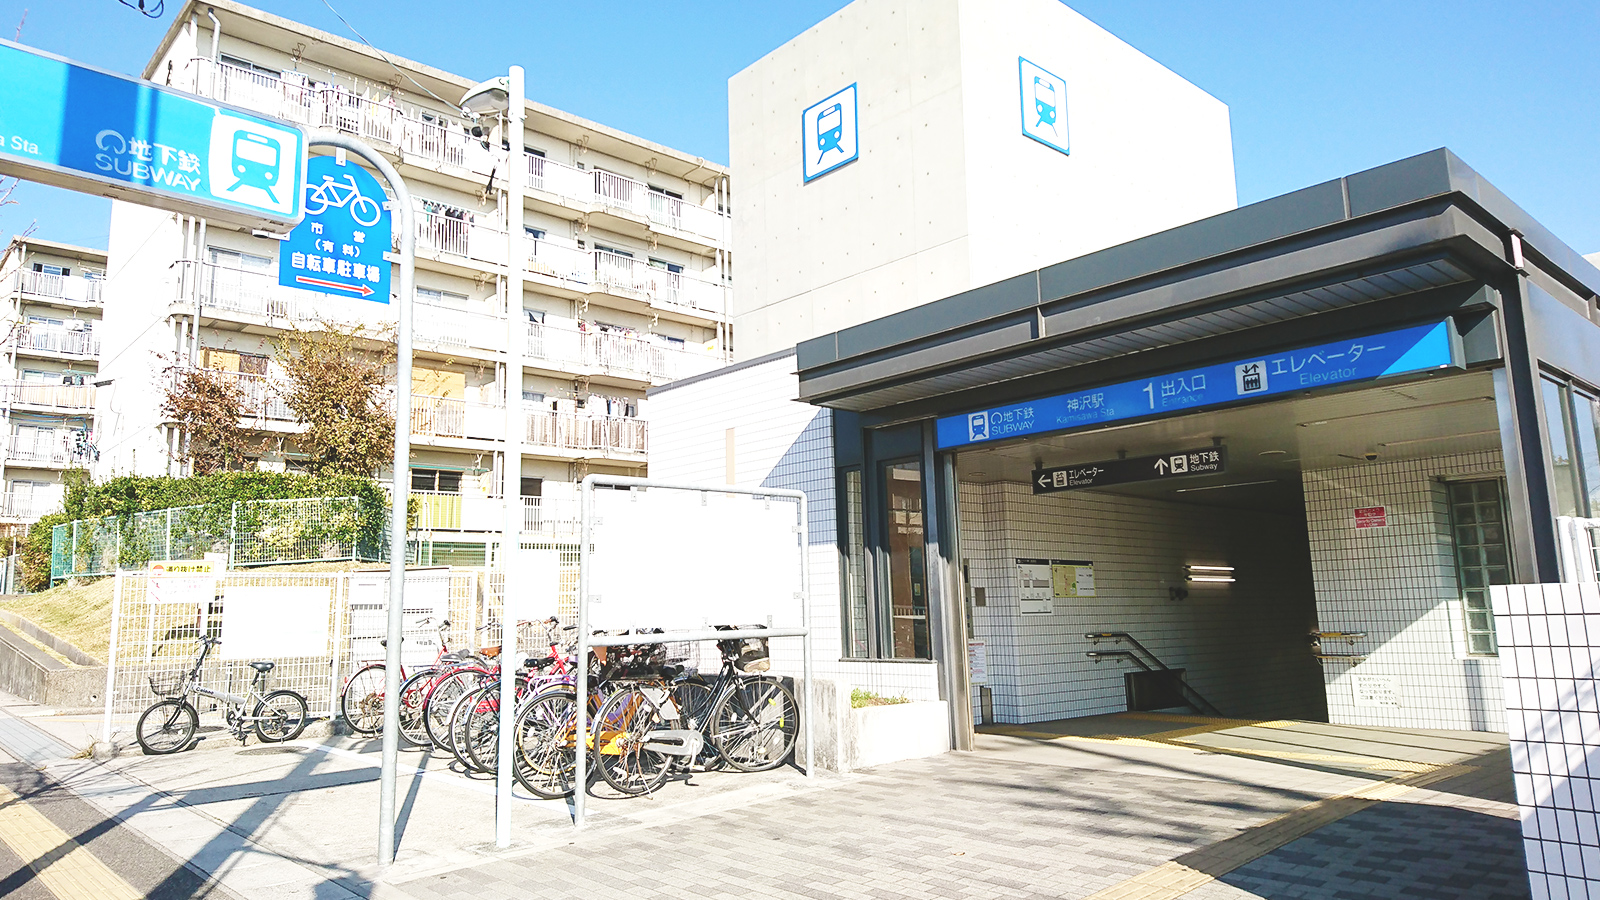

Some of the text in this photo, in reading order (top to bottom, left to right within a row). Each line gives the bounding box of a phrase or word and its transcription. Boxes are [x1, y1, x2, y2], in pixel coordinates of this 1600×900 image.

[128, 136, 201, 175] 地下鉄
[95, 153, 201, 192] SUBWAY
[291, 251, 381, 283] 自転車駐車場
[1271, 344, 1386, 376] エレベーター
[1300, 366, 1357, 385] Elevator
[1142, 374, 1206, 410] 1 出入口
[1066, 393, 1105, 413] 神沢駅
[1003, 407, 1035, 423] 地下鉄
[1056, 410, 1098, 424] Kamisawa
[991, 420, 1035, 436] SUBWAY
[1189, 450, 1220, 464] 地下鉄
[1068, 467, 1104, 480] エレベーター
[1190, 462, 1218, 473] Subway
[1068, 478, 1093, 487] Elevator
